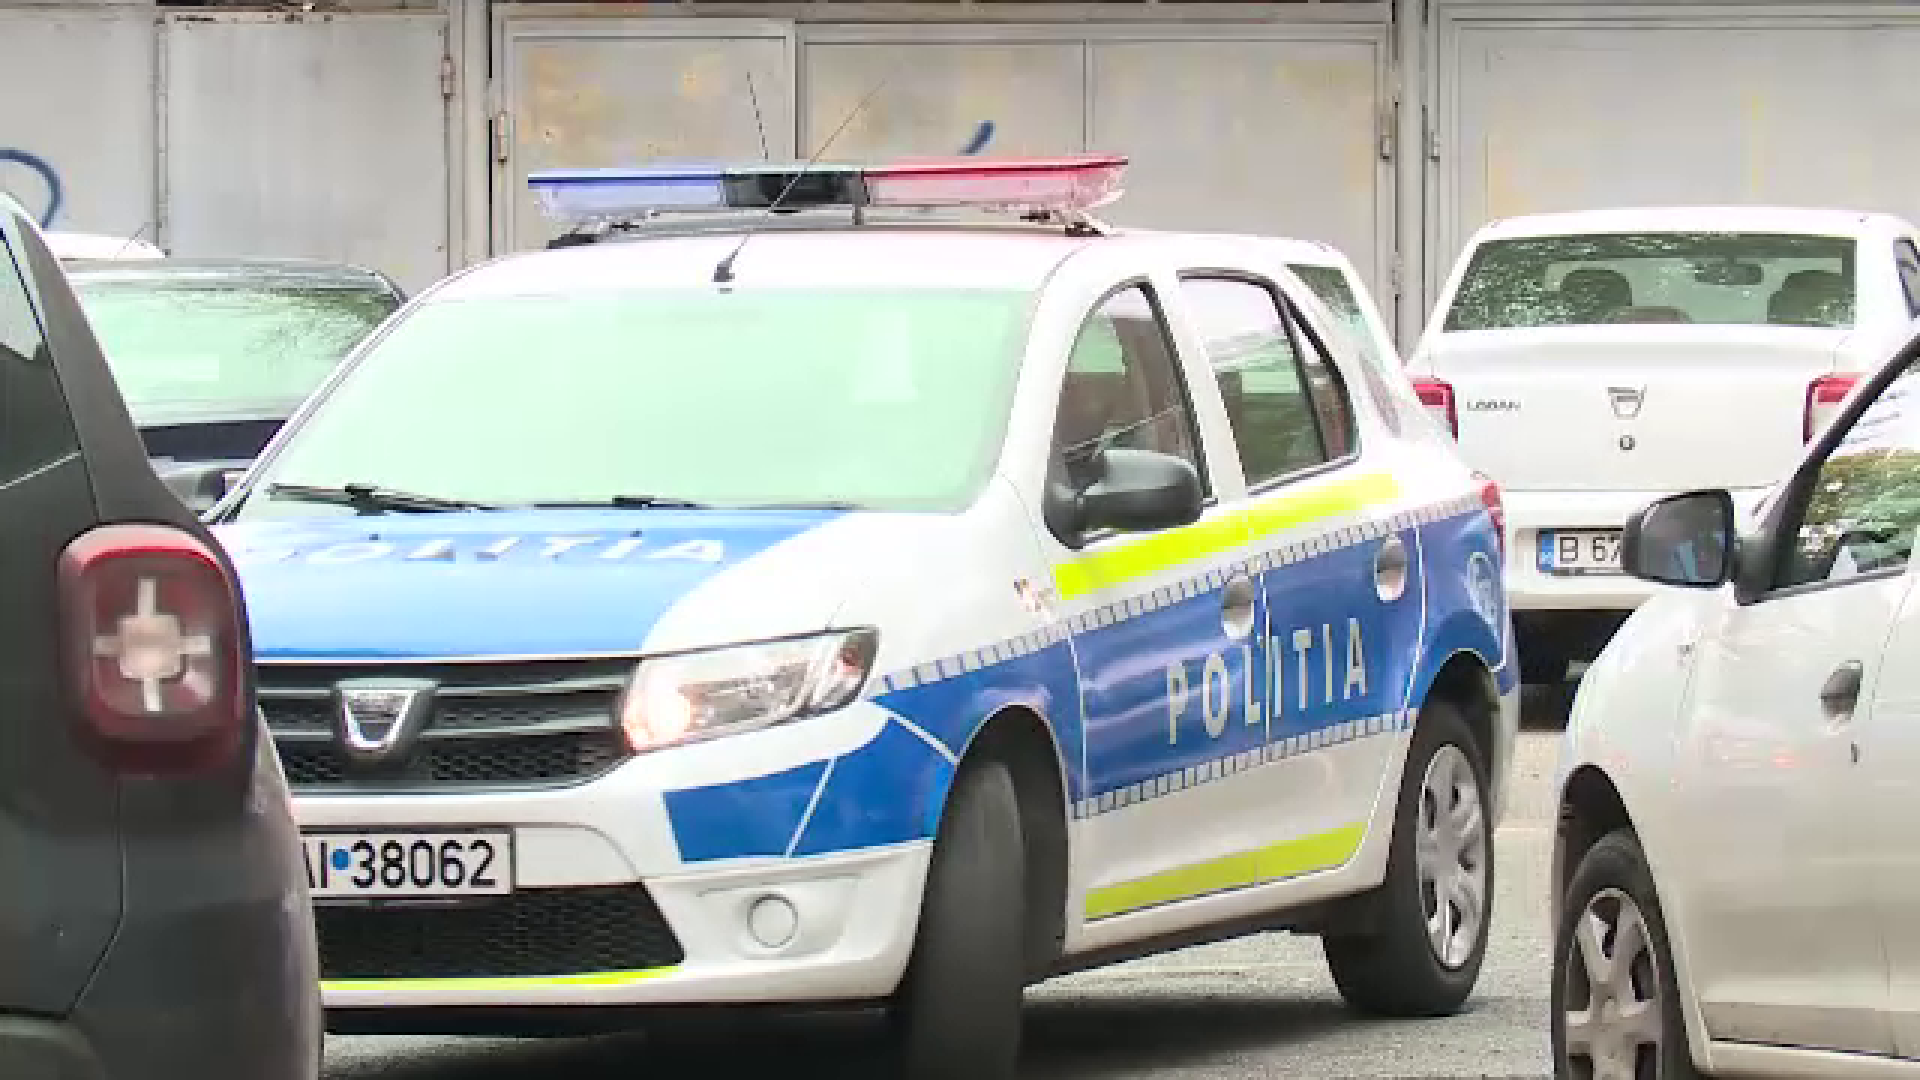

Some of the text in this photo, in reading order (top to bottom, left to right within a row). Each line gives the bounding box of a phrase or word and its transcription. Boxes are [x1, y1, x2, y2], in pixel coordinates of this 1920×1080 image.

[1559, 536, 1579, 563] B
[1166, 617, 1368, 745] POLITIA
[351, 839, 498, 889] 38062
